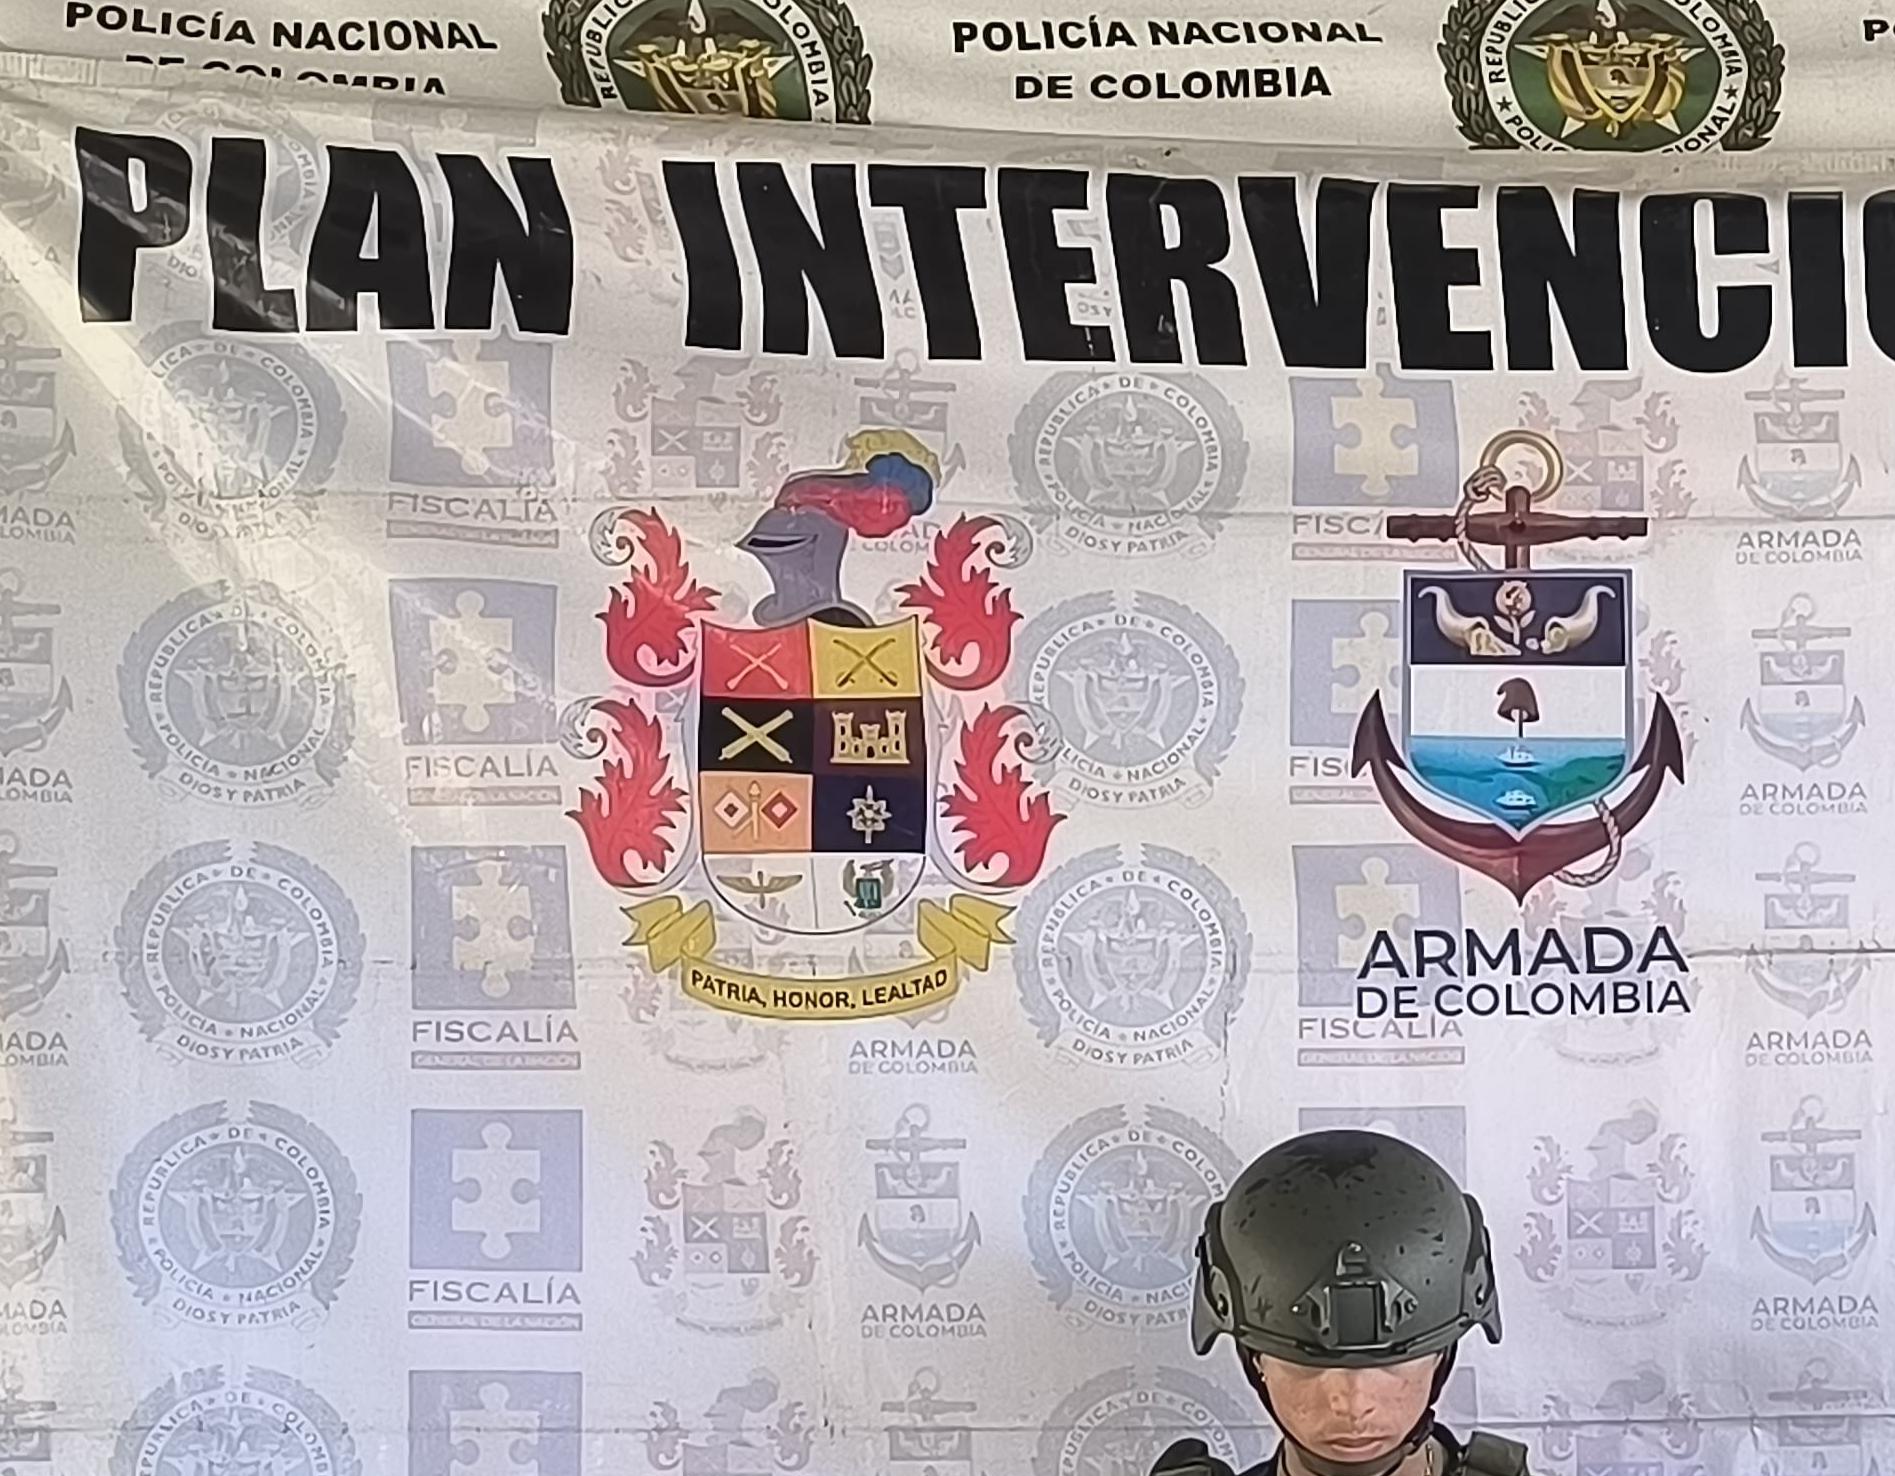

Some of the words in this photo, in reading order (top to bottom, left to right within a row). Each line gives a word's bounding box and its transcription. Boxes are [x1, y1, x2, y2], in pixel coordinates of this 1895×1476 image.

[66, 2, 256, 45] POLICÍA
[273, 20, 498, 51] NACIONAL
[952, 16, 1136, 54] POLICÍA
[1149, 20, 1383, 49] NACIONAL
[1015, 73, 1075, 101] DE
[1091, 66, 1331, 101] COLOMBIA
[76, 126, 575, 336] PLAN
[1736, 527, 1862, 549] ARMADA
[1739, 781, 1868, 801] ARMADA
[1357, 925, 1688, 981] ARMADA
[690, 968, 766, 1008] PATRIA,
[773, 989, 857, 1010] HONOR,
[862, 969, 948, 1007] LEALTAD
[1356, 987, 1420, 1019] DE
[1433, 981, 1691, 1018] COLOMBIA
[848, 1038, 977, 1059] ARMADA
[1746, 1029, 1873, 1050] ARMADA
[860, 1302, 987, 1324] ARMADA
[1752, 1295, 1879, 1316] ARMADA
